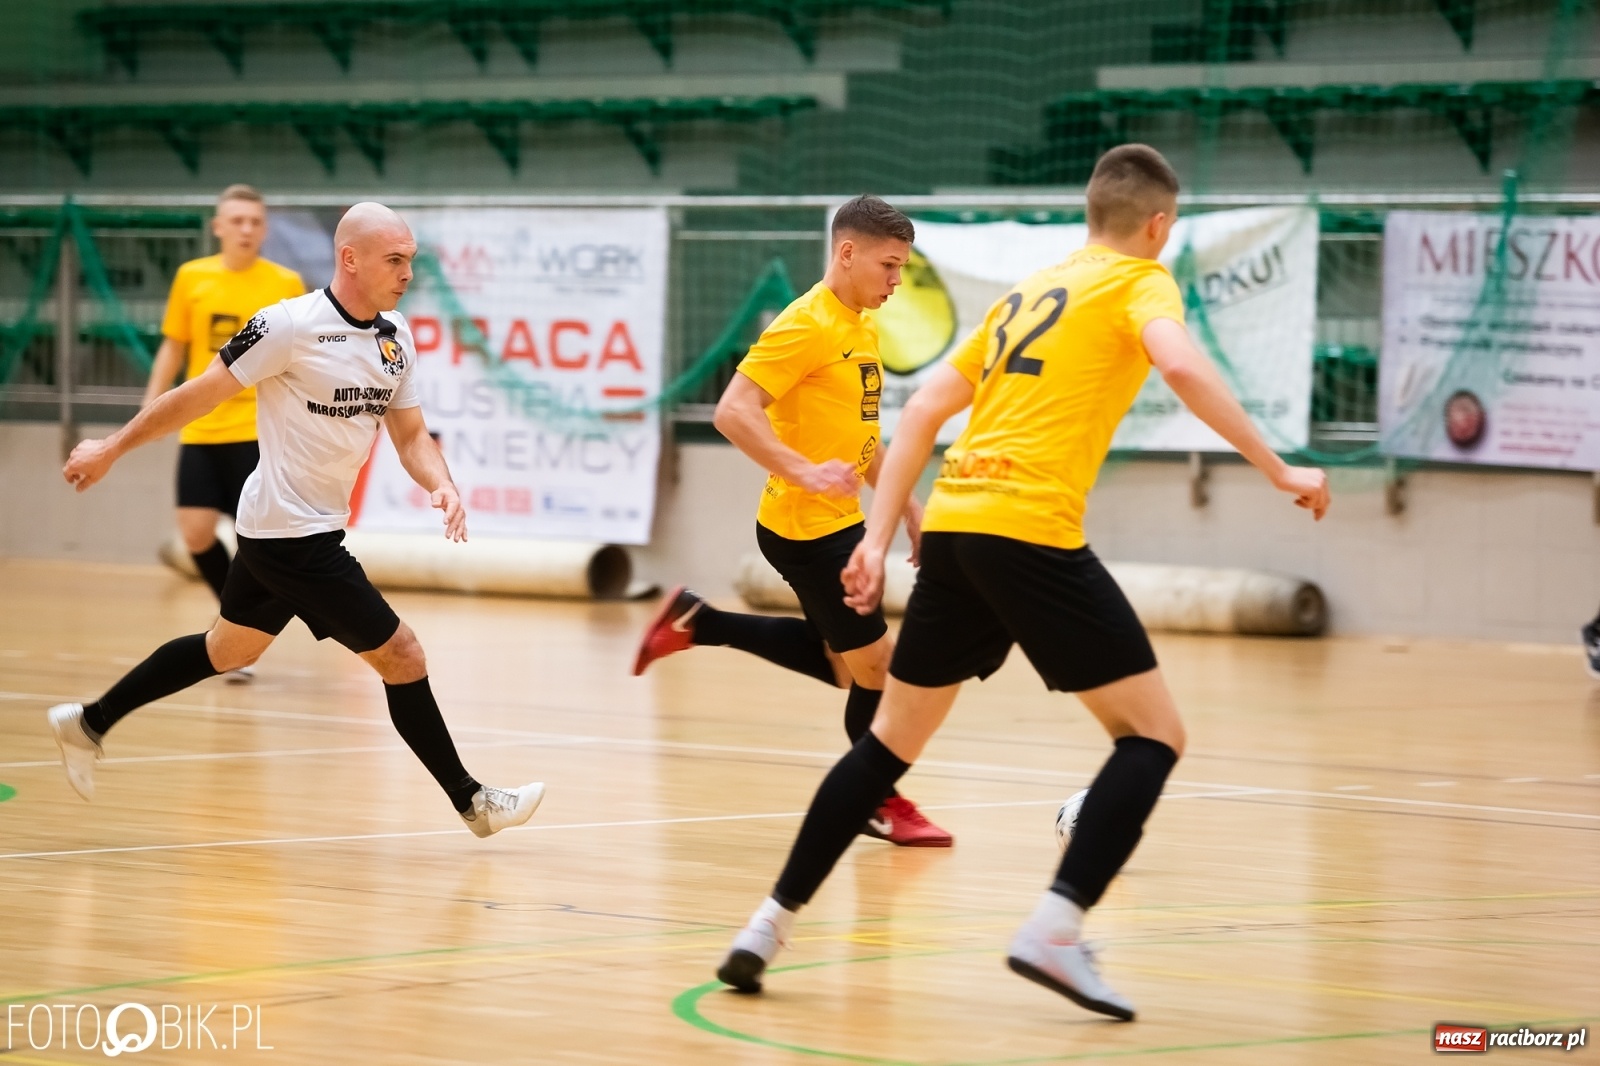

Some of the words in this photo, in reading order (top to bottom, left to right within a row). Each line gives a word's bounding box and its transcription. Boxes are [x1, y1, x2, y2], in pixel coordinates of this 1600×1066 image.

[539, 243, 644, 277] WORK
[326, 335, 347, 343] VIGO
[414, 315, 643, 372] PRACA
[981, 287, 1068, 383] 32
[454, 429, 646, 474] NIEMCY
